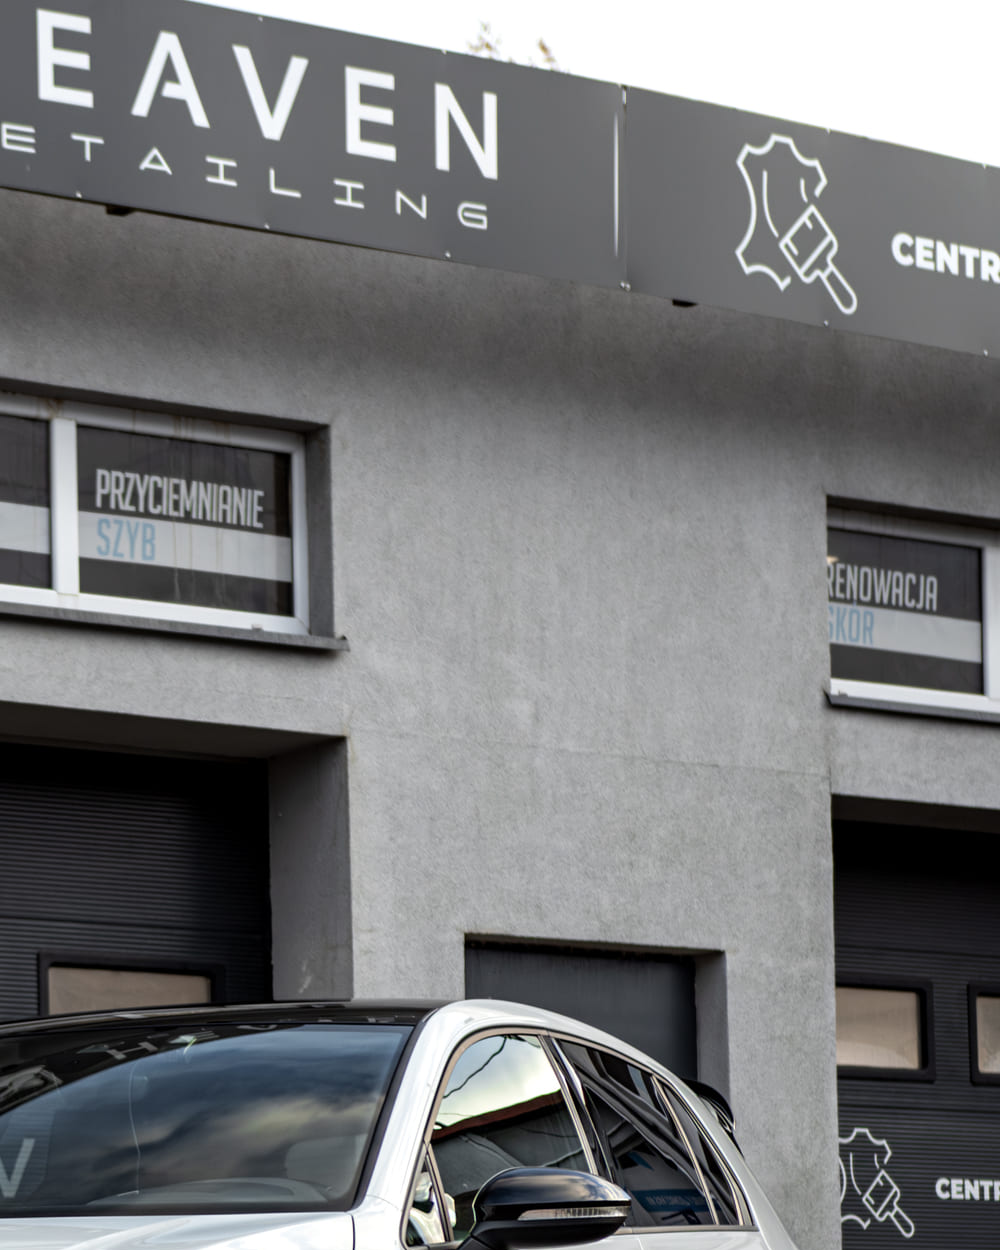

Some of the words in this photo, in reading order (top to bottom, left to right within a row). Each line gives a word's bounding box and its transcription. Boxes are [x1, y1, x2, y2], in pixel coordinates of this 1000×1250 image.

[891, 232, 1000, 284] CENTR
[95, 468, 265, 529] PRZYCIEMNIANIE
[96, 518, 156, 562] SZYB
